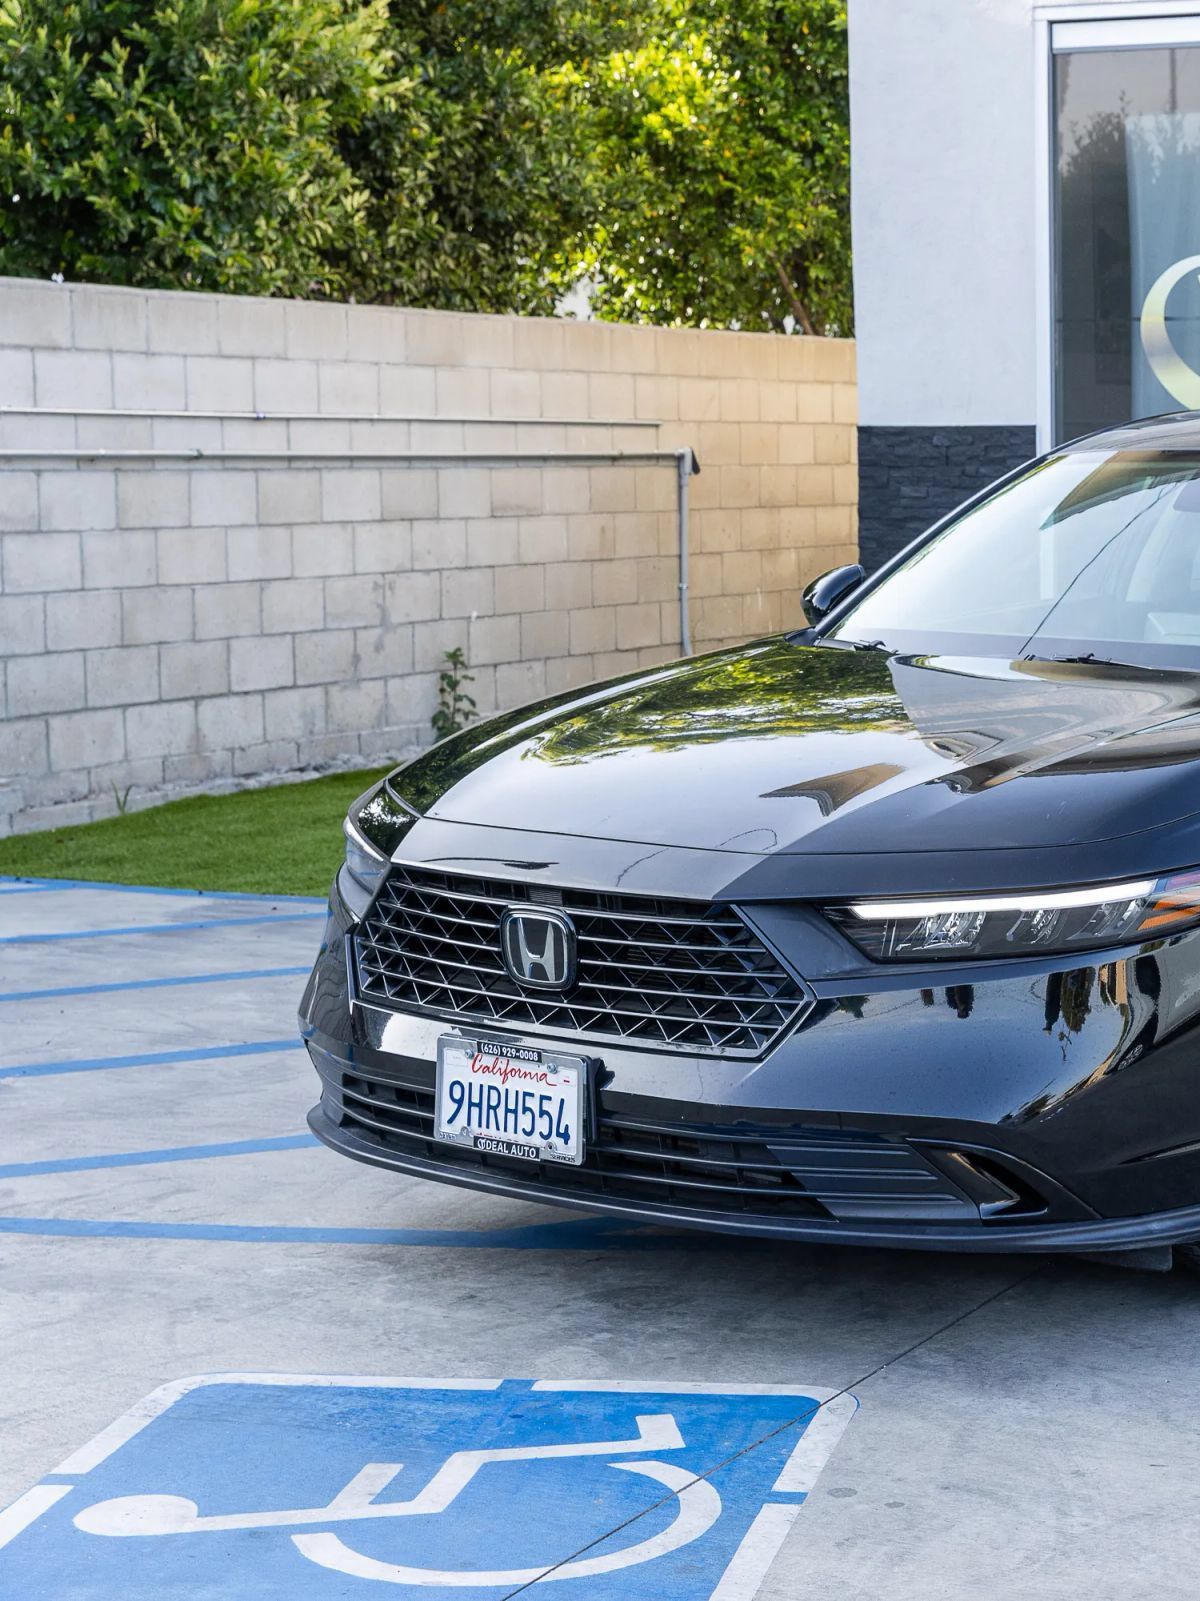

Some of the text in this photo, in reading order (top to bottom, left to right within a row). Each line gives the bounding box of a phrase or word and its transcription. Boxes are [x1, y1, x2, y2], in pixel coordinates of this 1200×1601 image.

[481, 1043, 538, 1061] (626) 929-0008
[471, 1053, 557, 1086] California
[447, 1080, 570, 1145] 9HRH554
[511, 1144, 537, 1158] AUTO
